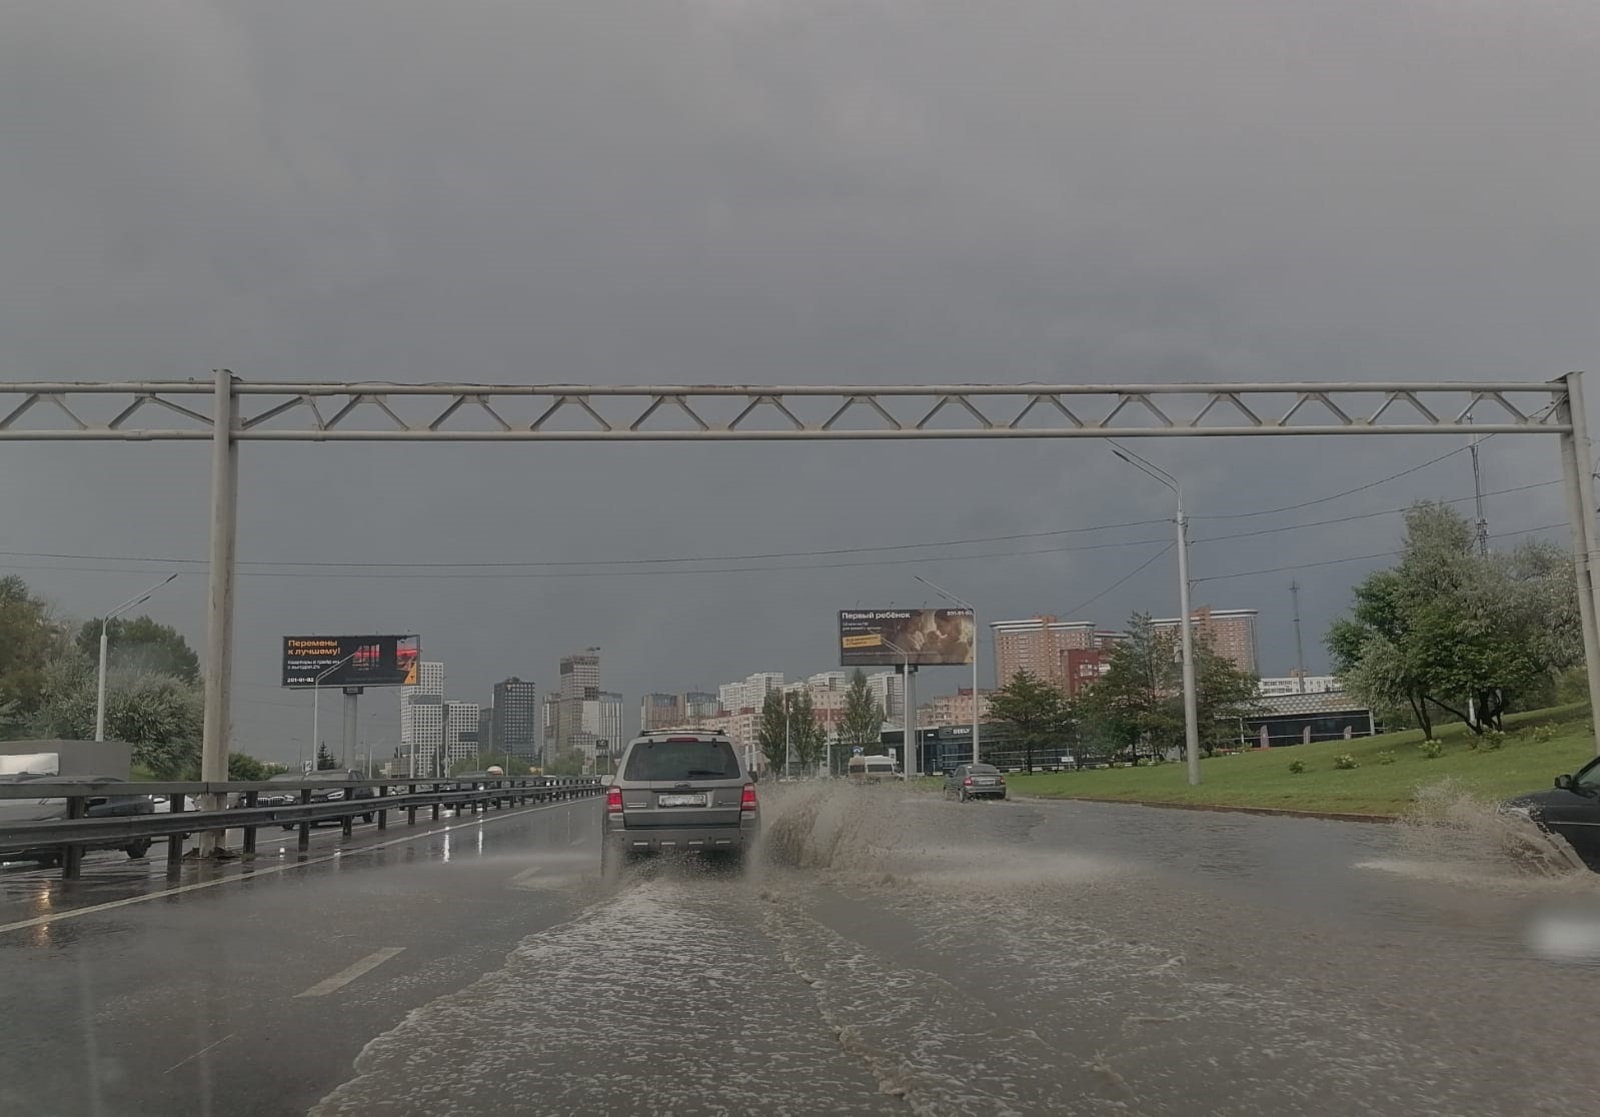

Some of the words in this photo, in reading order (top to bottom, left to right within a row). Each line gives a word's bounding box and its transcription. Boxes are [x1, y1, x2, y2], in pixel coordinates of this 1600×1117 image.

[842, 612, 874, 620] Первый
[875, 612, 910, 620] ребёнок
[288, 640, 337, 648] Перемены
[295, 647, 341, 656] лучшему!
